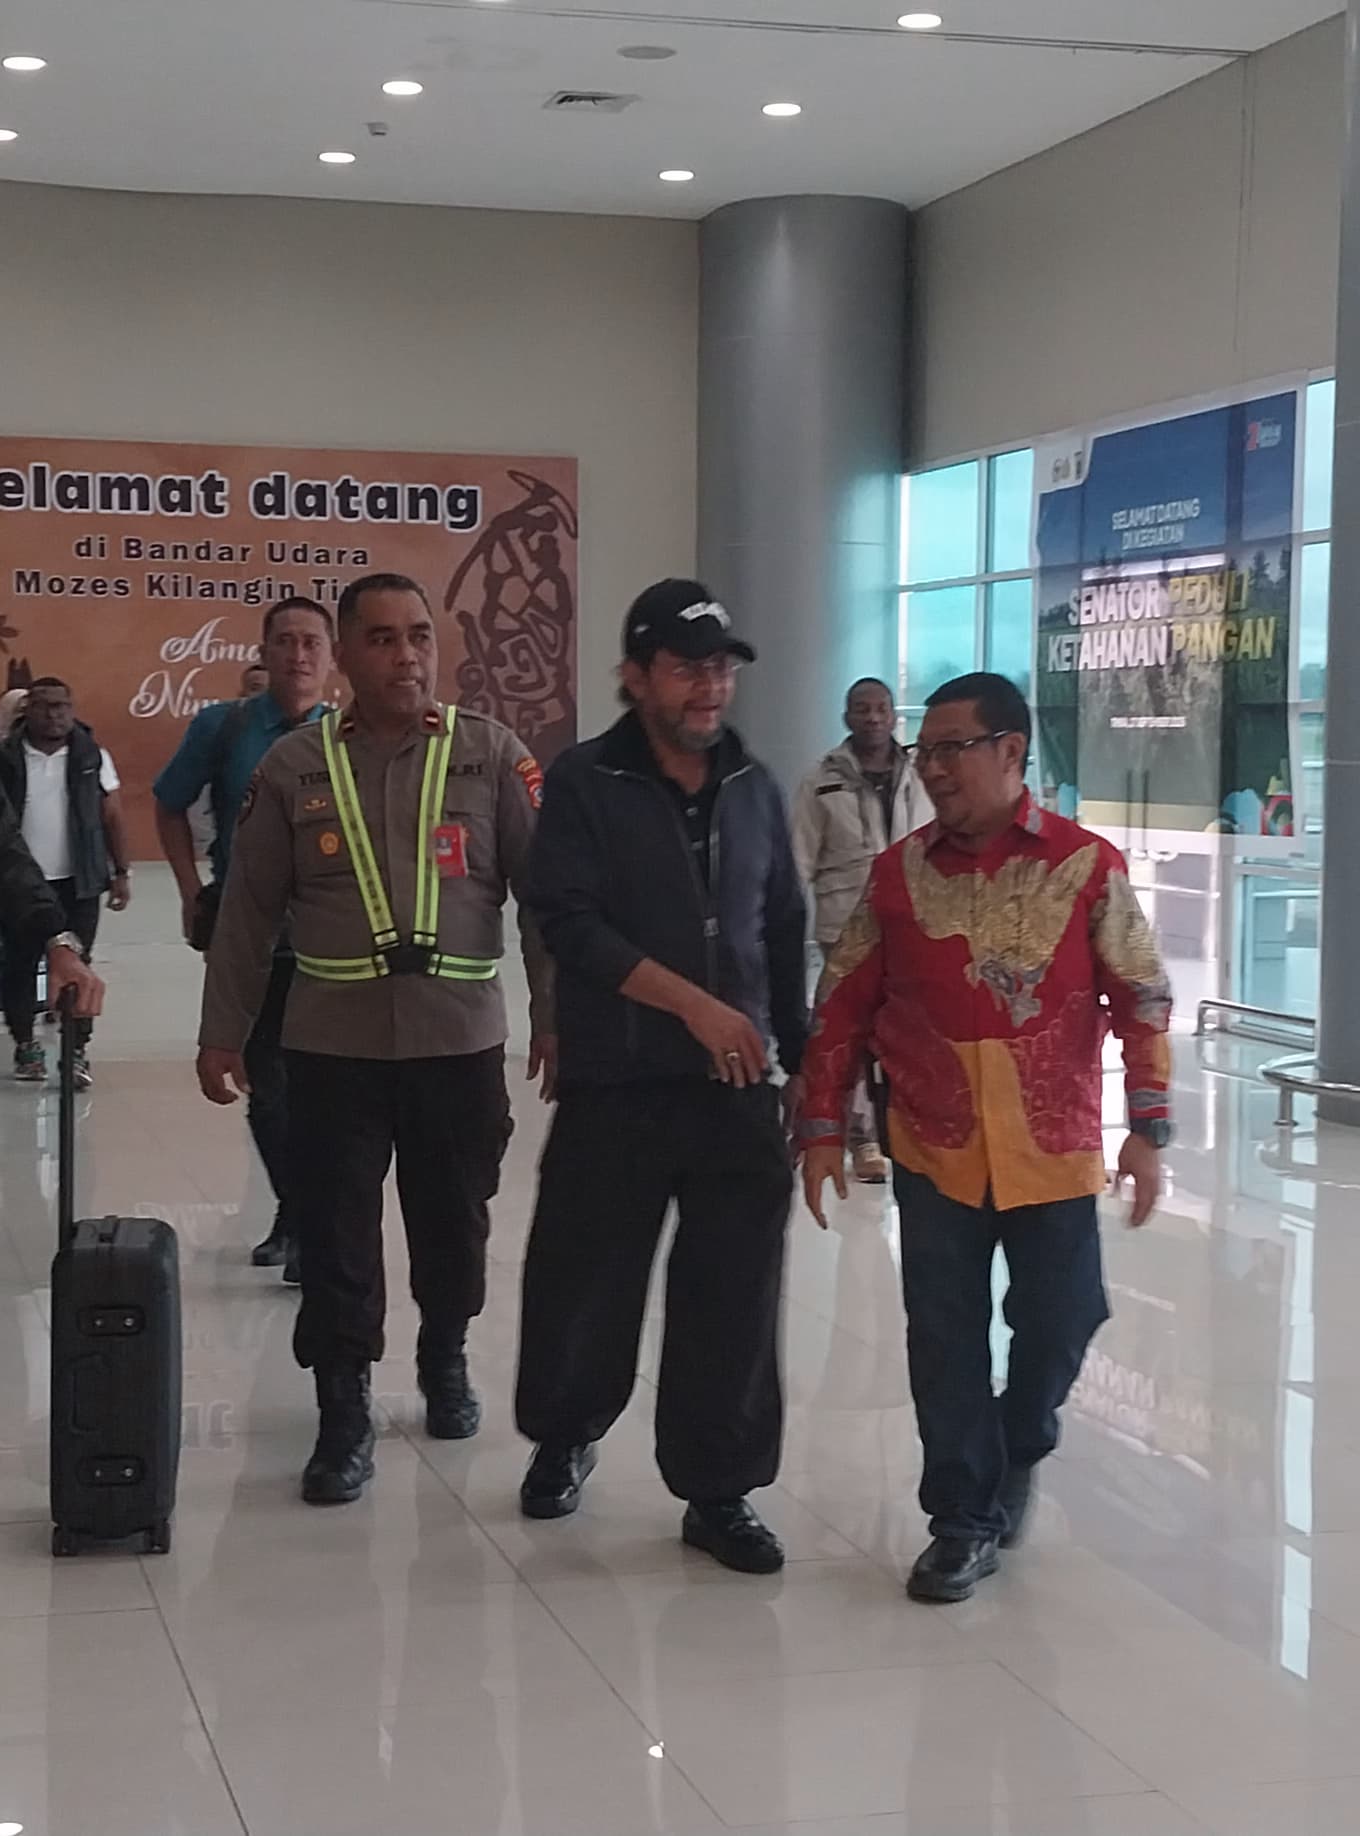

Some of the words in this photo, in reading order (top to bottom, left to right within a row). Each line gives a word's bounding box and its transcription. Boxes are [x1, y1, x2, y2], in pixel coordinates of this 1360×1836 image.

[250, 472, 482, 531] datang
[74, 535, 107, 560] di
[124, 537, 252, 564] Bandar
[267, 541, 369, 567] Udara
[14, 570, 130, 598] Mozes
[146, 574, 296, 605] Kilangin
[1068, 579, 1160, 626] SENATOR
[1169, 569, 1250, 614] PEDULI
[1047, 625, 1167, 673] KETAHANAN
[1171, 616, 1275, 662] PANGAN
